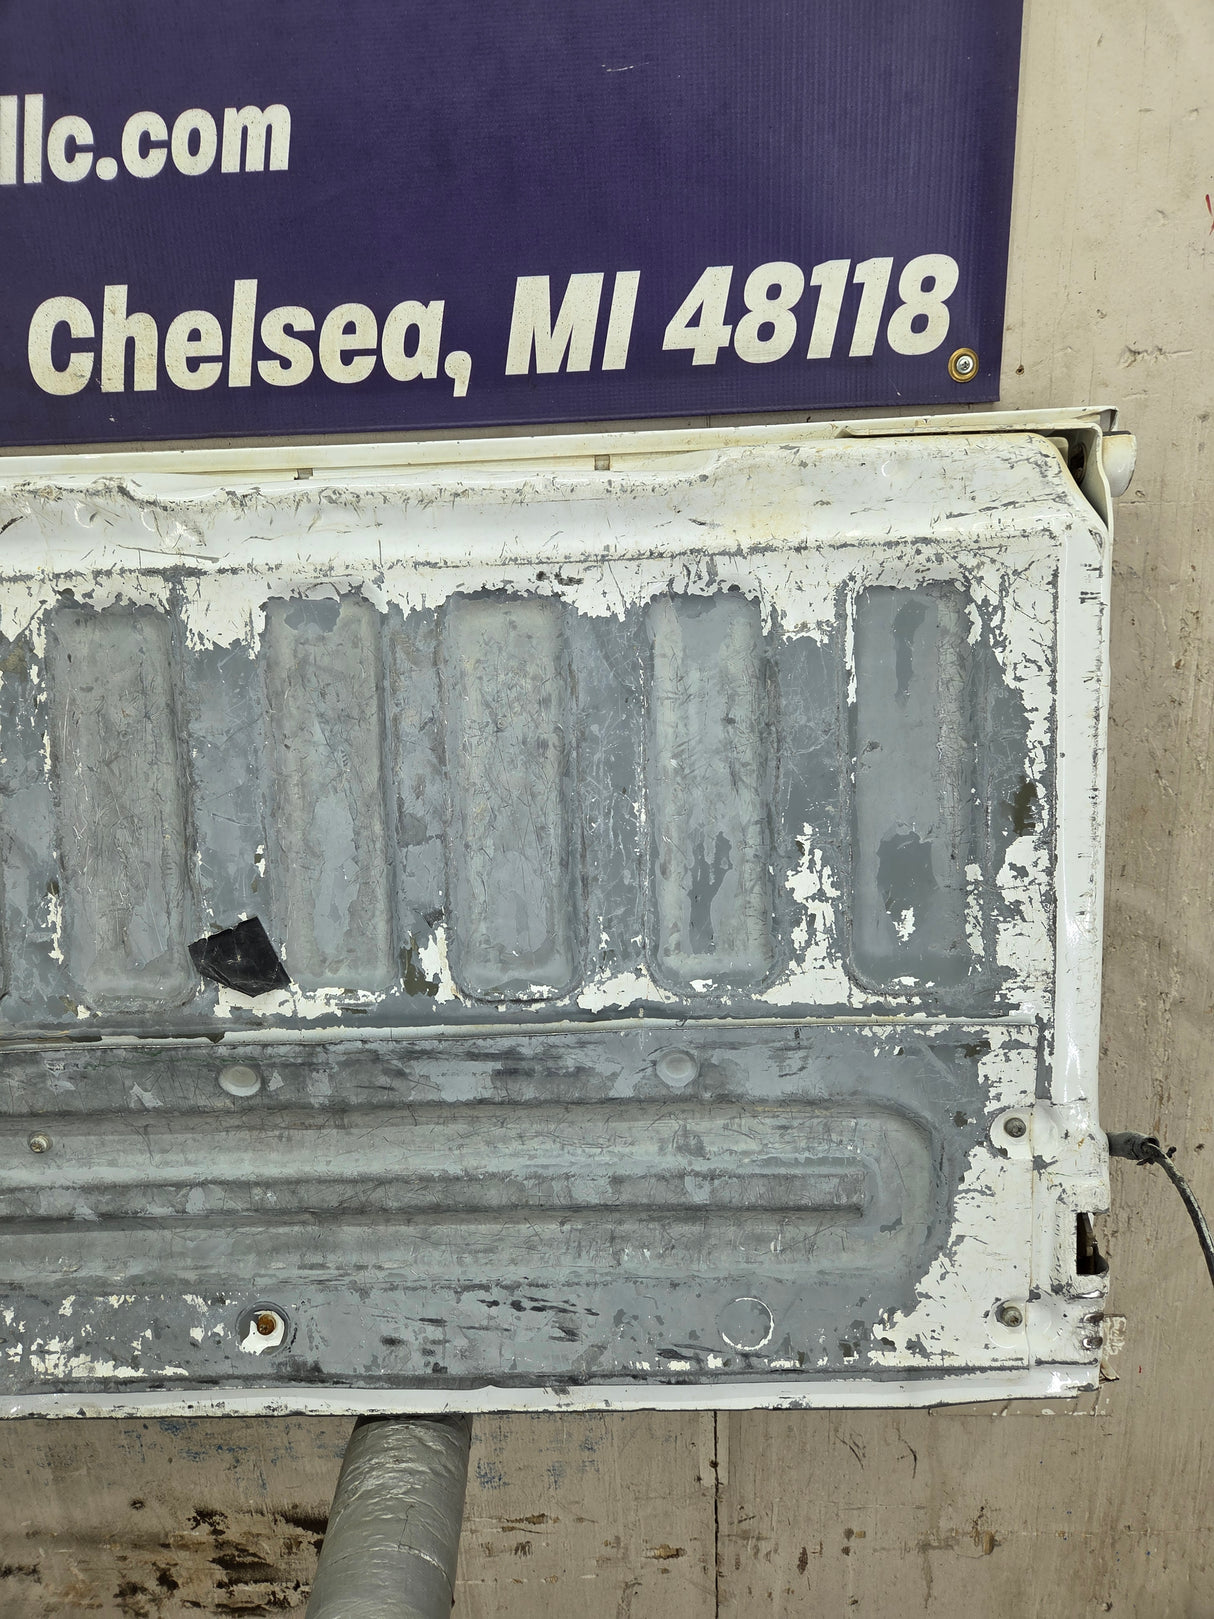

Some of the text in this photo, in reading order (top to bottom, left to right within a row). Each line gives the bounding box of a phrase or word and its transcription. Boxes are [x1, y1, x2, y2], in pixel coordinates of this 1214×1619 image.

[0, 93, 292, 186] llc.com
[27, 253, 960, 398] Chelsea, MI 48118
